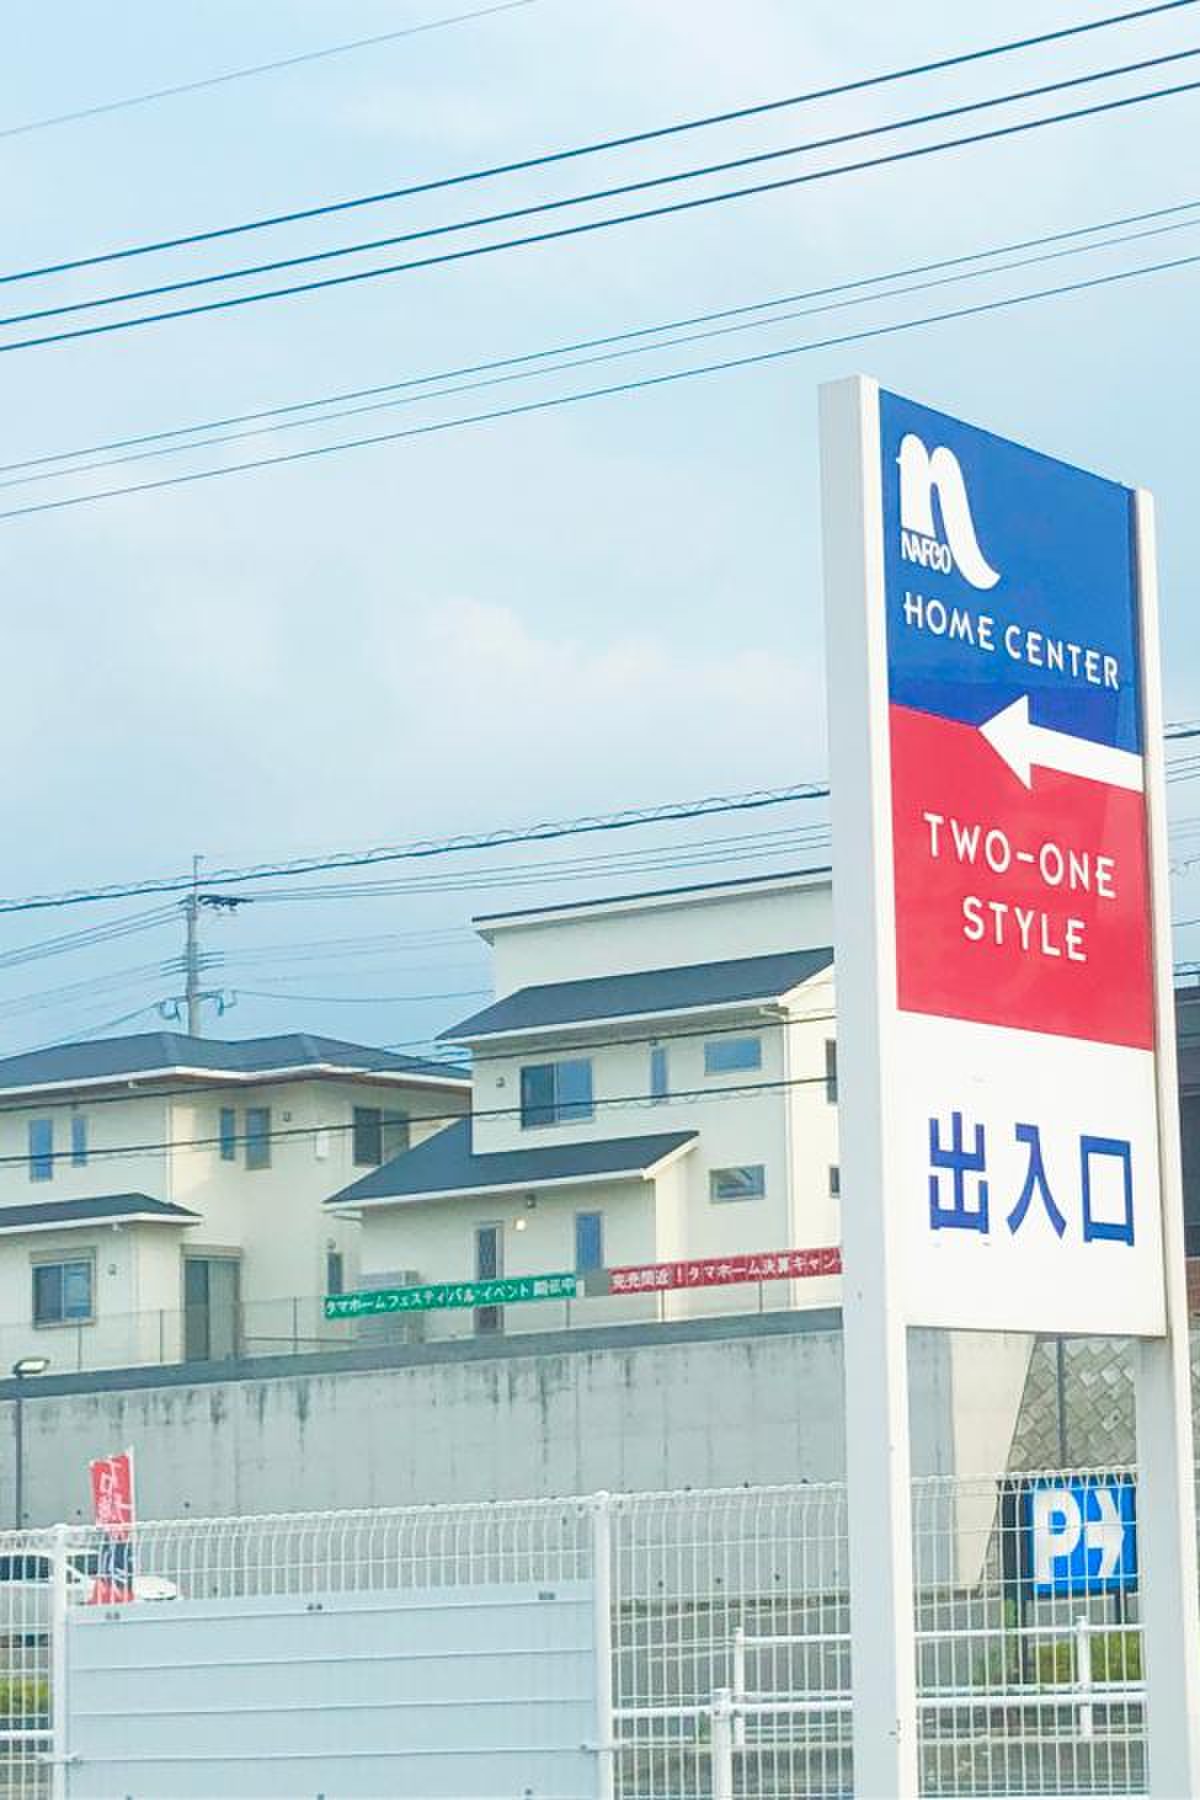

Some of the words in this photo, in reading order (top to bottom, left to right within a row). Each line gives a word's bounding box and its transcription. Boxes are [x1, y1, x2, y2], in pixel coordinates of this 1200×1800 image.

[901, 531, 952, 575] NAFCO
[904, 591, 995, 651] HOME
[1005, 625, 1120, 690] CENTER
[923, 812, 1117, 898] TWO-ONE
[963, 896, 1087, 961] STYLE
[928, 1111, 1135, 1247] 出入口
[611, 1252, 843, 1289] 完売間近！タマホーム決算キャン
[1034, 1489, 1082, 1584] P
